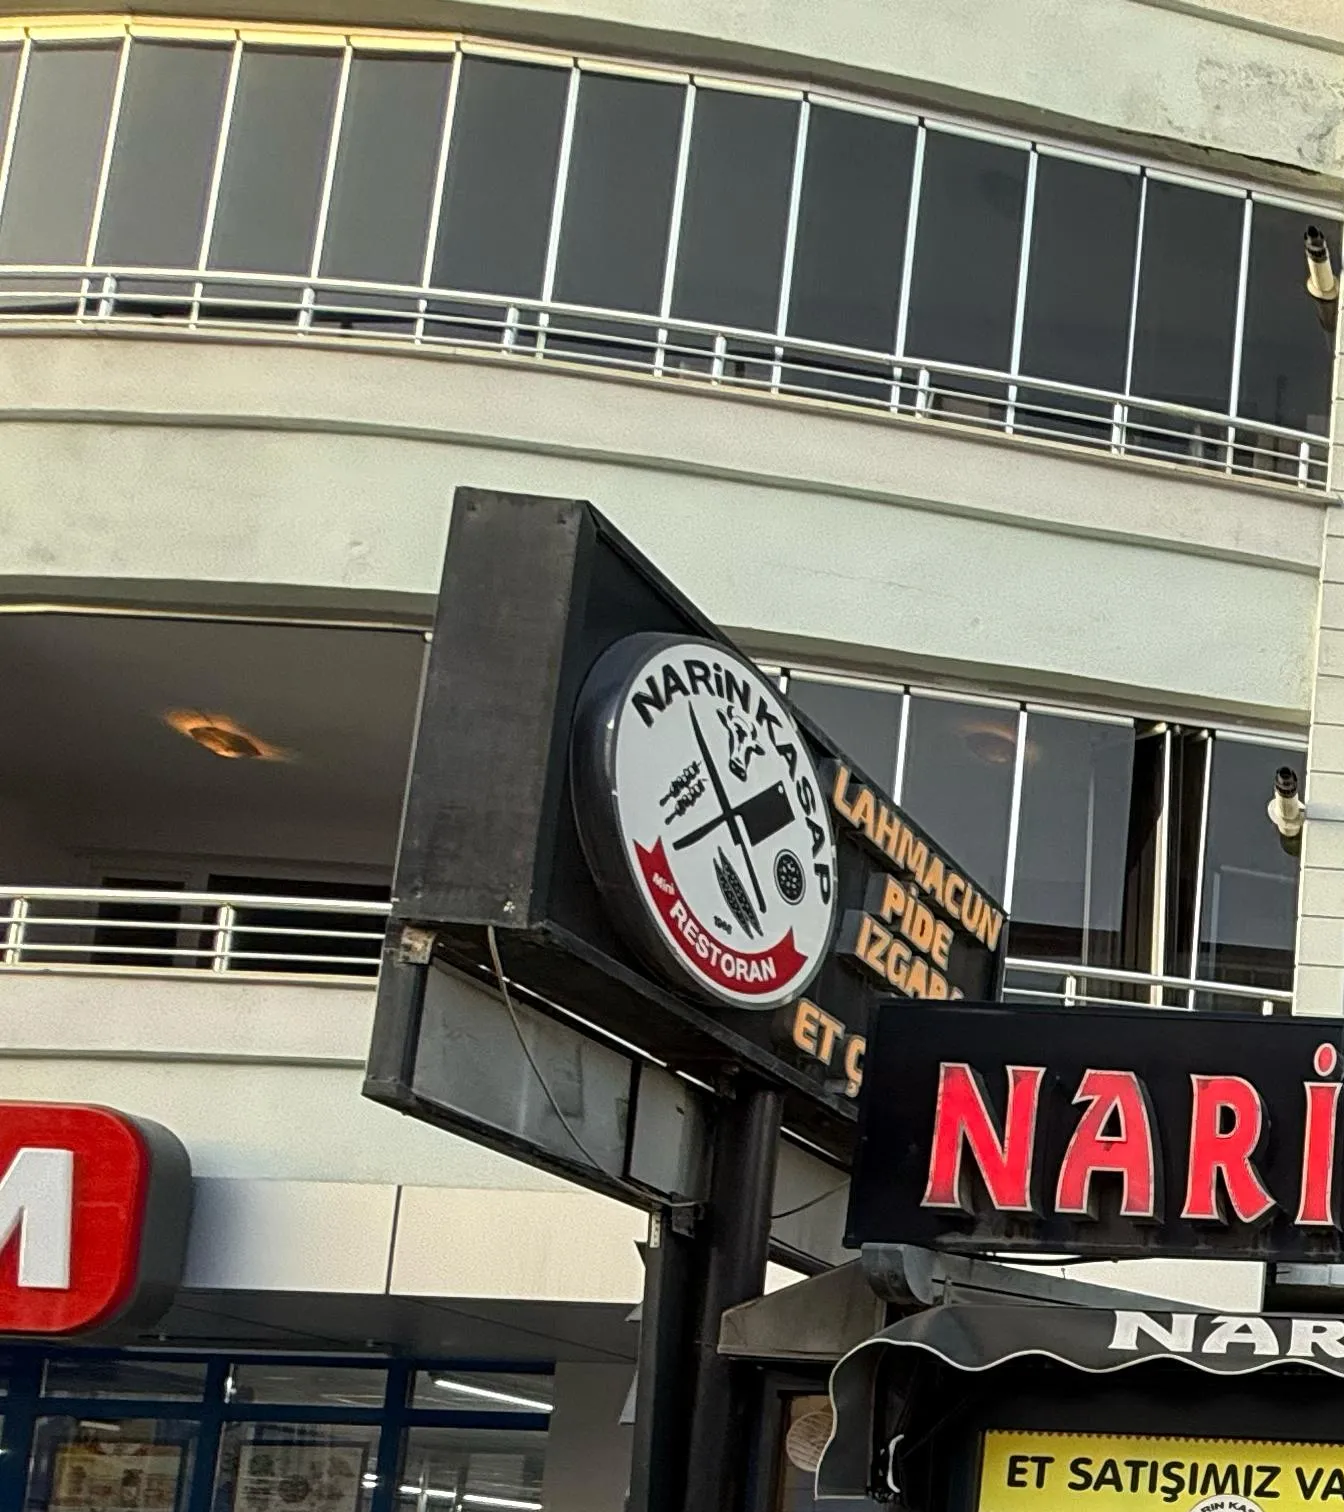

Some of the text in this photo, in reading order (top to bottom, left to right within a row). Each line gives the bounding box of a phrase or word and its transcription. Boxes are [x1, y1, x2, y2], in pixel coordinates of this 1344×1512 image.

[756, 695, 831, 905] KASAP
[833, 765, 1003, 951] LAHMACUN
[669, 899, 777, 983] RESTORAN
[856, 915, 964, 1000] IZGAR
[793, 998, 846, 1066] ET
[1007, 1454, 1055, 1489] ET
[1068, 1455, 1281, 1502] SATIŞIMIZ
